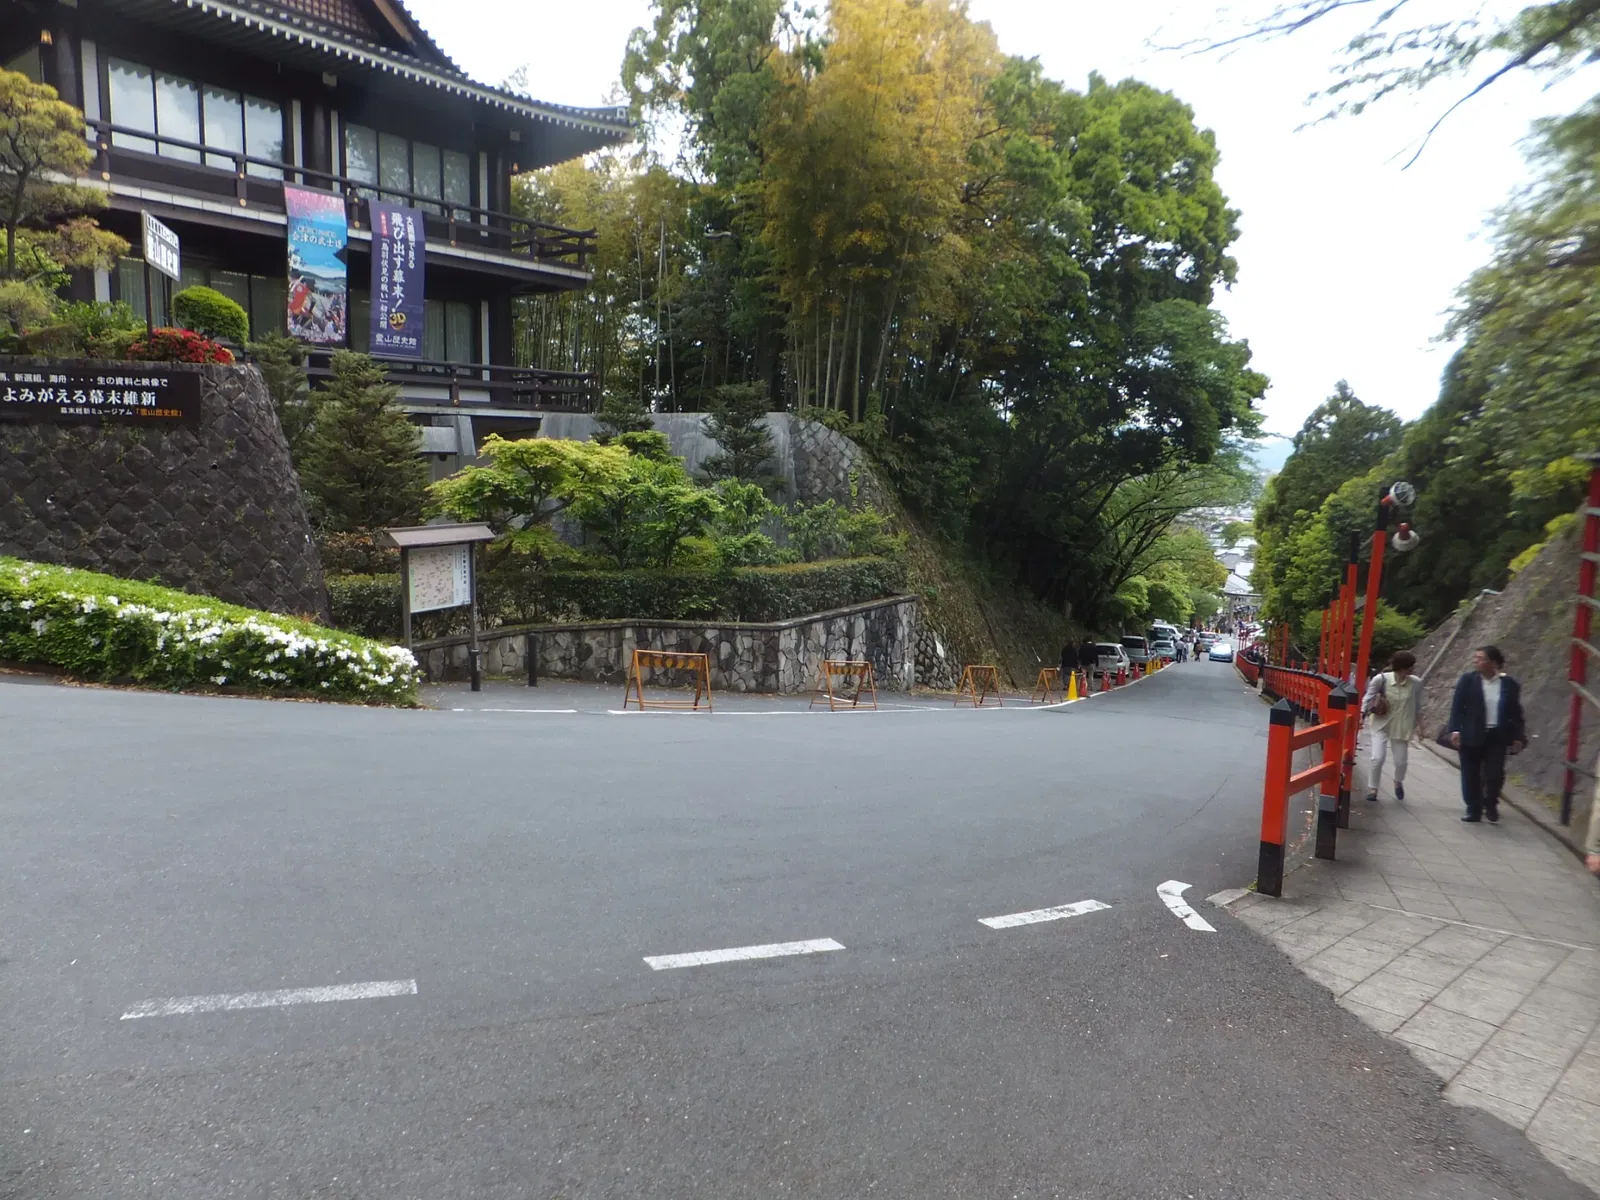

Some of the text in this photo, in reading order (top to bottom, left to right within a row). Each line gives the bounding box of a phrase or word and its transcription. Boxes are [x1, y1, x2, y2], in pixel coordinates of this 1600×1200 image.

[389, 312, 406, 325] 3D
[3, 387, 156, 406] よみがえる幕末維新
